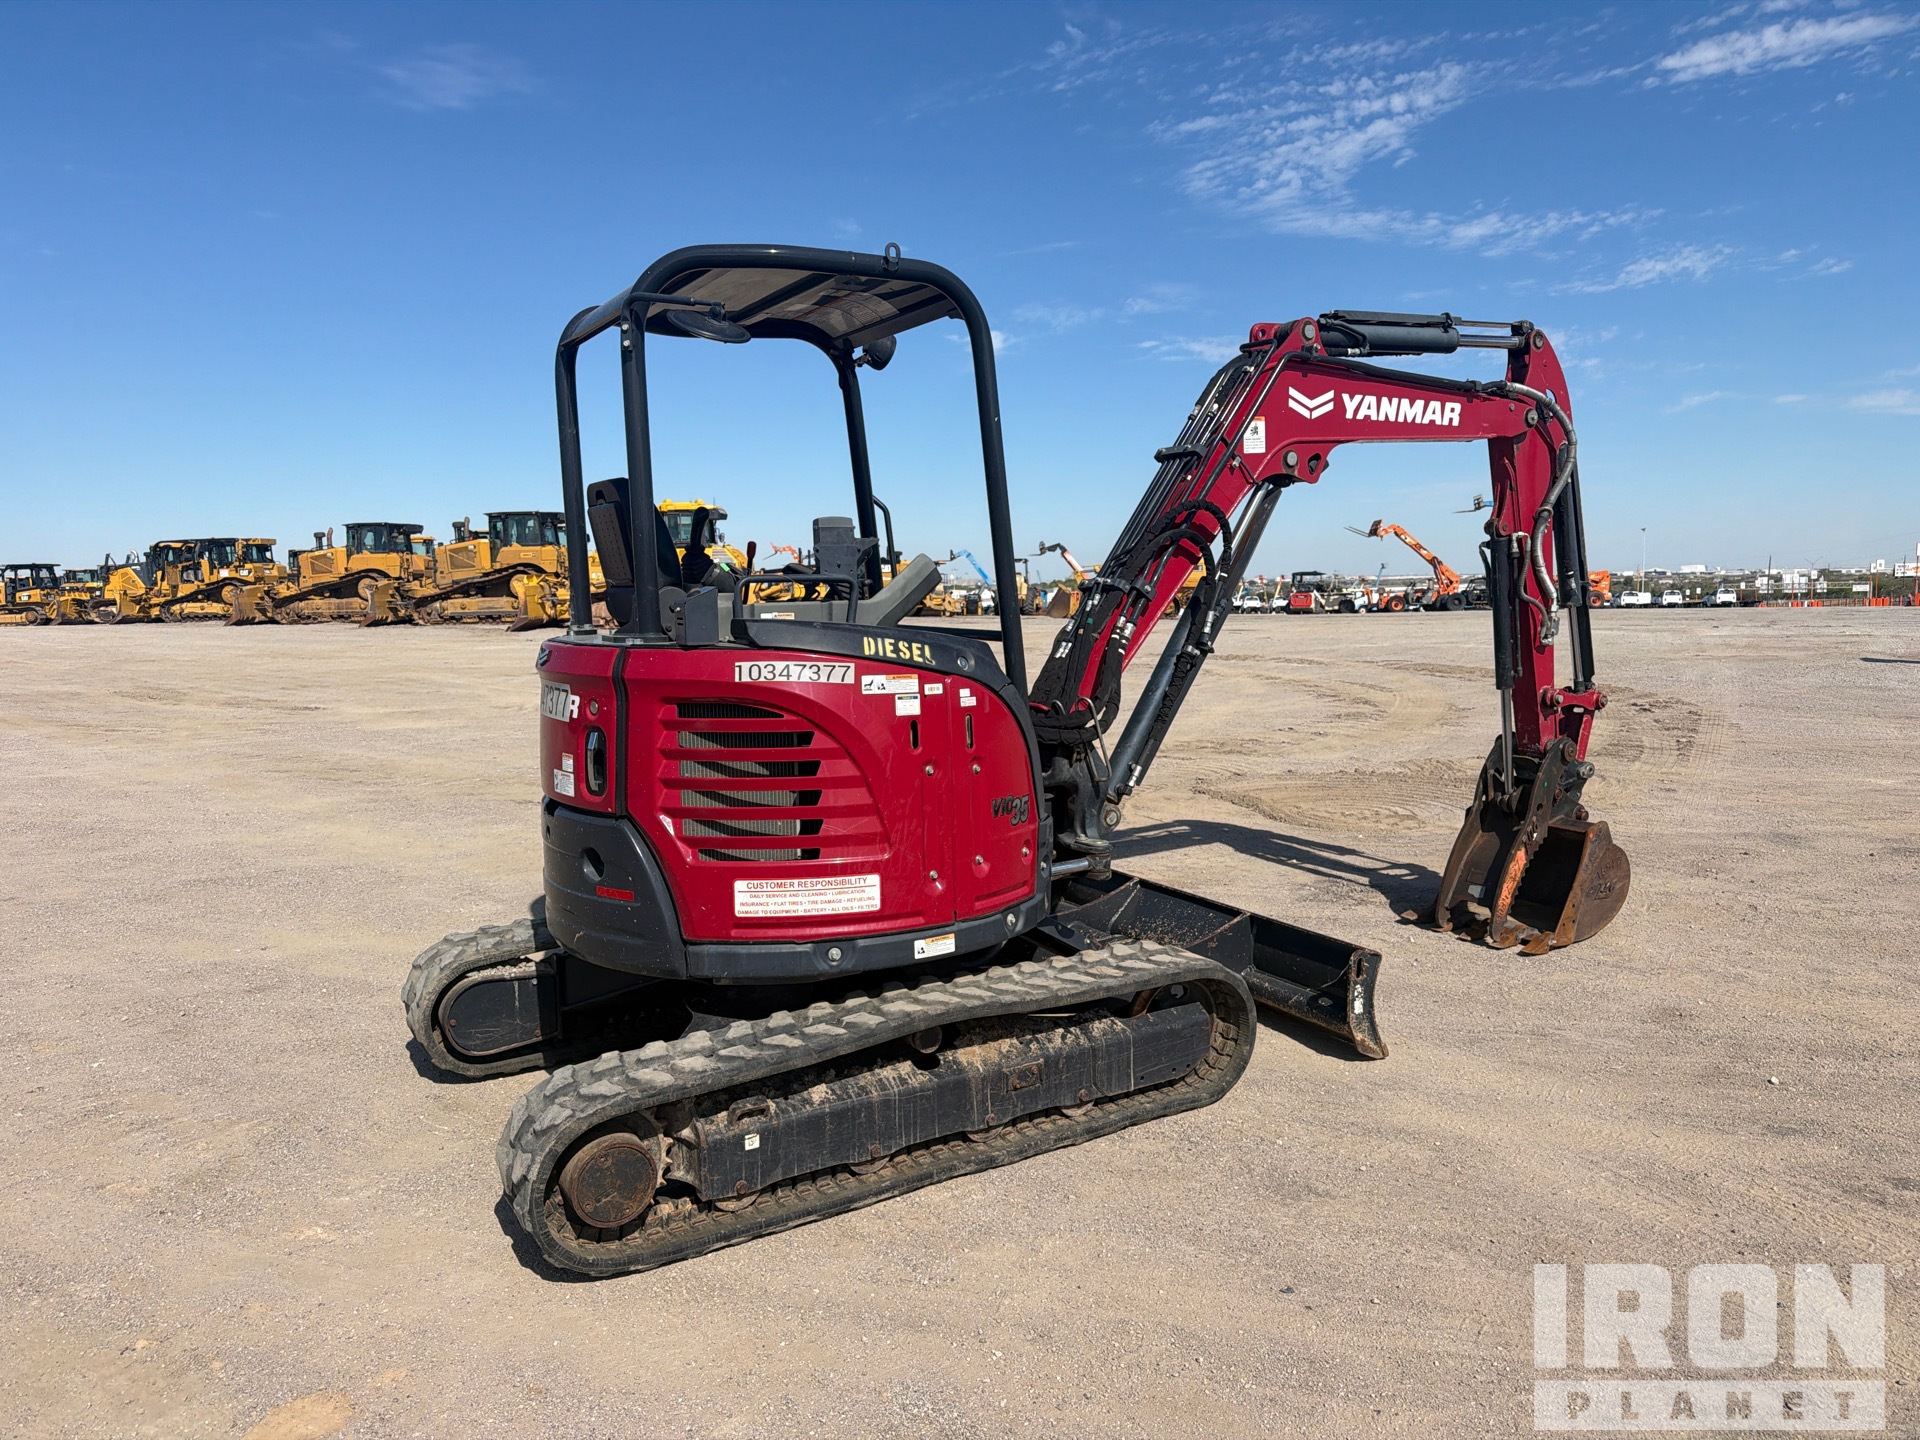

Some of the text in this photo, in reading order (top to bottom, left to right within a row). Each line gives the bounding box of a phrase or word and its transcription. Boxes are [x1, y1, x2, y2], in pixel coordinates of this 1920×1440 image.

[1341, 393, 1462, 427] YANMAR
[863, 636, 936, 666] DIESEL
[735, 663, 851, 682] 10347377
[746, 876, 868, 890] CUSTOMER RESPONSIBILITY
[846, 895, 876, 903] REFUELING
